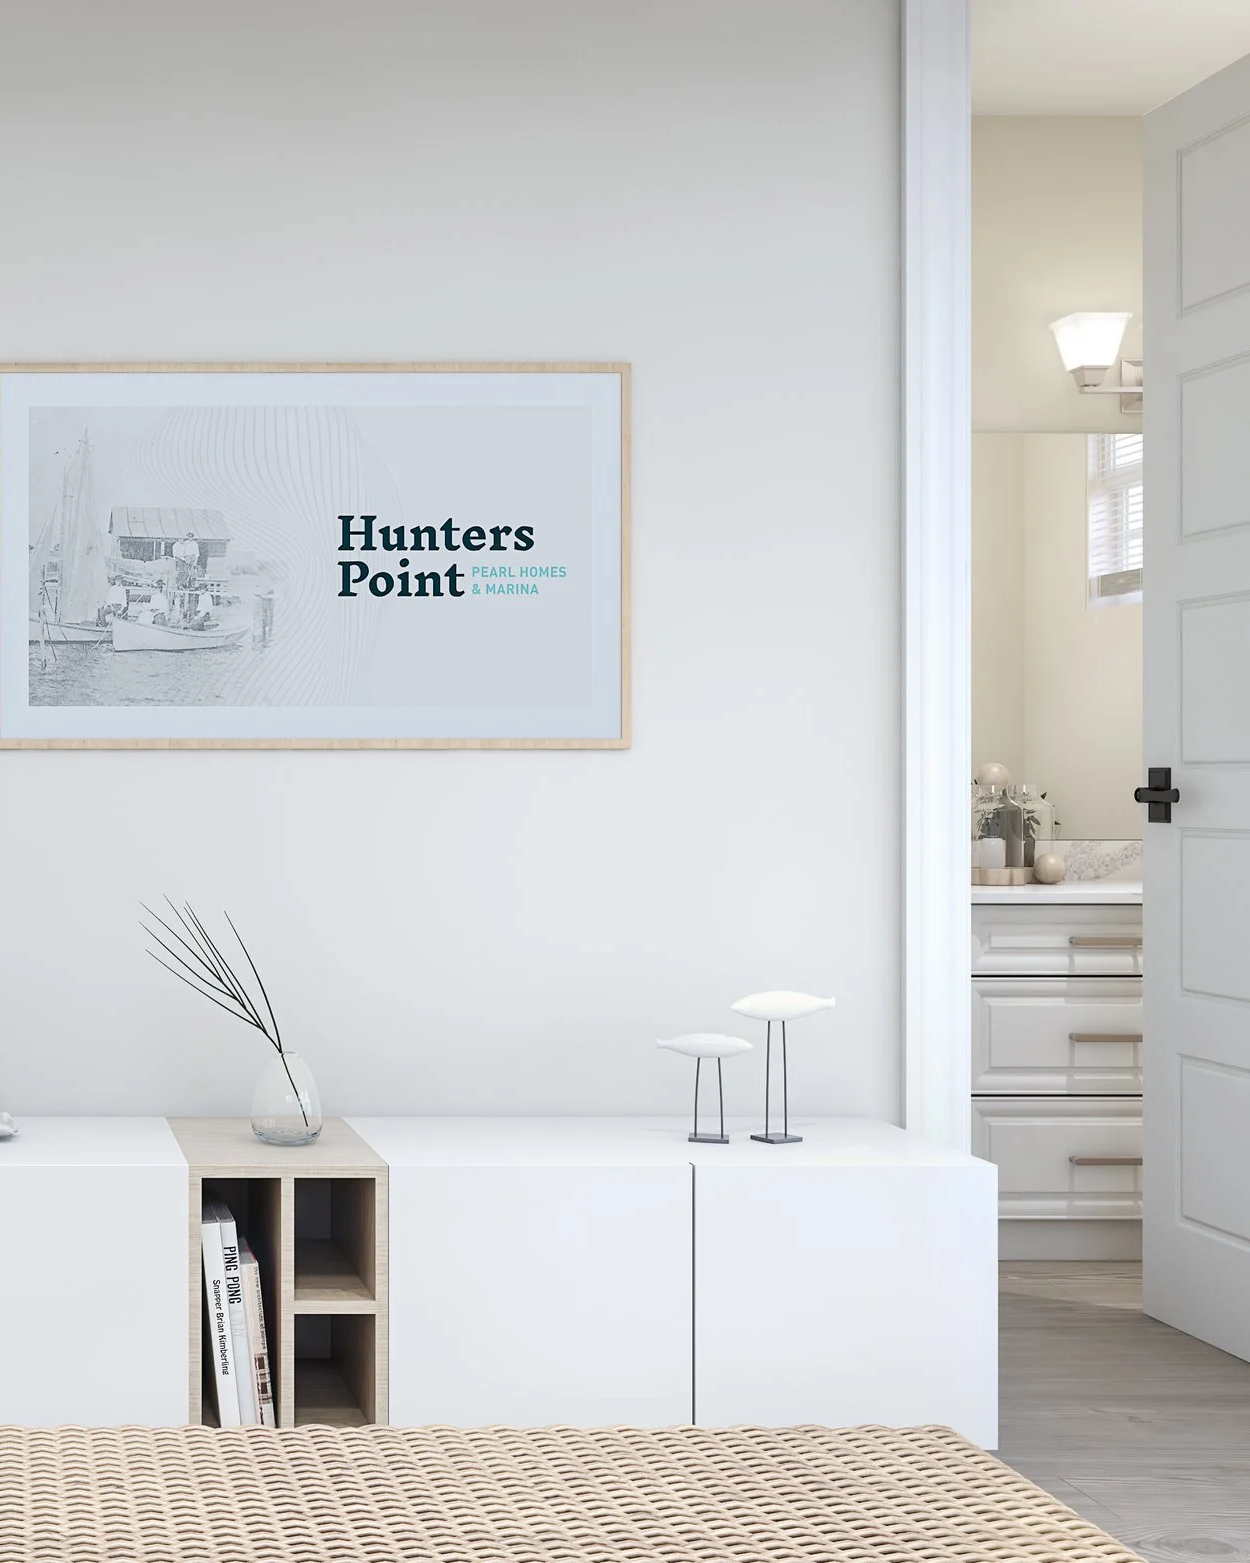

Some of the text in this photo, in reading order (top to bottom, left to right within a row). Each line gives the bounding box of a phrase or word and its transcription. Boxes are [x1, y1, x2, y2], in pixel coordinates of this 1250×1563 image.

[337, 514, 535, 552] Hunters
[337, 557, 466, 598] Point
[471, 566, 567, 578] PEARL HOMES
[471, 583, 539, 595] & MARINA
[223, 1246, 239, 1271] PING
[212, 1279, 222, 1310] Snapper
[226, 1276, 242, 1304] PONG
[216, 1312, 225, 1333] Brian
